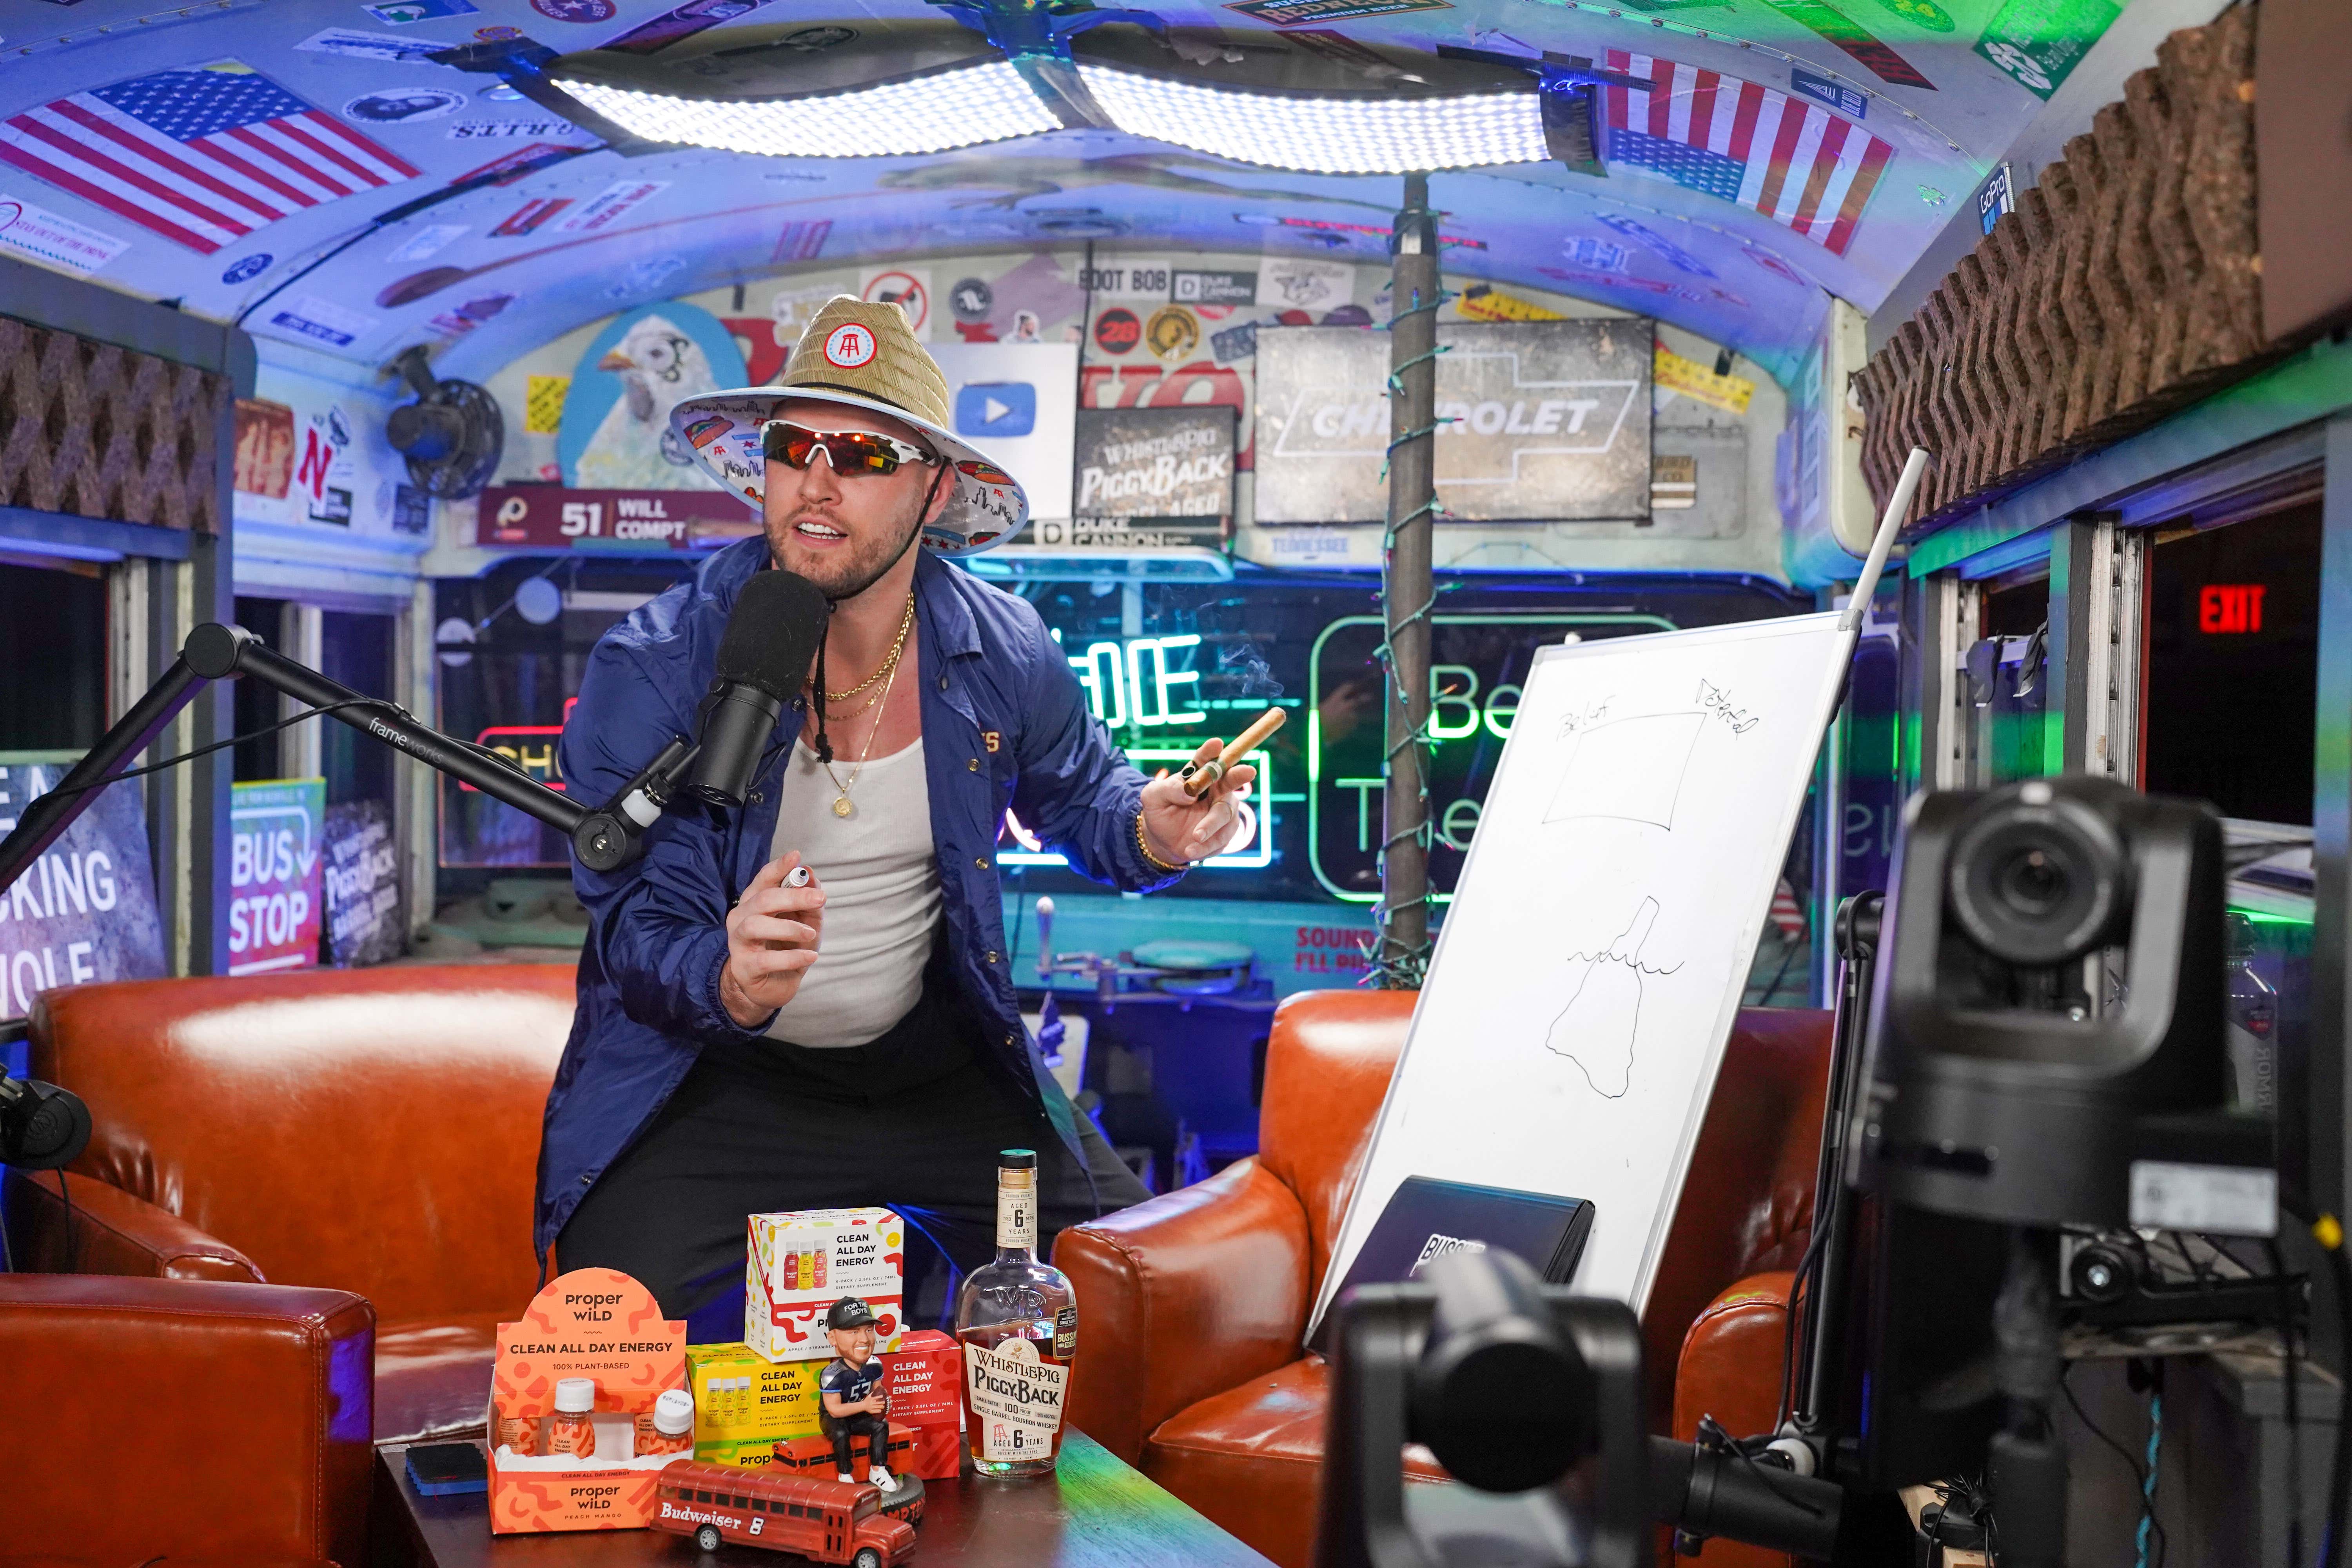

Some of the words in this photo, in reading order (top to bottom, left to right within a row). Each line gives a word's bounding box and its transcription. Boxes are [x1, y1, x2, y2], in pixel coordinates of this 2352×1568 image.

[1301, 9, 1368, 20] PREMIUM
[1980, 175, 2005, 214] GoPro
[1132, 270, 1166, 291] BOB
[1079, 453, 1228, 509] PIGGYBACK
[559, 502, 603, 536] 51
[617, 499, 668, 518] WILL
[615, 520, 686, 540] COMPT
[2200, 584, 2267, 634] EXIT
[231, 828, 294, 887] BUS
[229, 890, 308, 953] STOP
[1015, 1209, 1024, 1227] 6
[837, 1234, 869, 1243] CLEAN
[837, 1247, 855, 1255] ALL
[858, 1245, 877, 1254] DAY
[836, 1257, 875, 1267] ENERGY
[844, 1304, 858, 1312] FOR
[851, 1307, 867, 1316] BOYS
[510, 1344, 556, 1354] CLEAN
[559, 1344, 585, 1353] ALL
[589, 1343, 615, 1353] DAY
[619, 1342, 673, 1352] ENERGY
[893, 1361, 926, 1371] CLEAN
[974, 1348, 1060, 1383] WHISTLEPIG
[761, 1371, 795, 1380] CLEAN
[893, 1374, 912, 1383] ALL
[914, 1372, 934, 1381] DAY
[761, 1383, 780, 1392] ALL
[782, 1382, 802, 1391] DAY
[893, 1383, 932, 1395] ENERGY
[974, 1365, 1060, 1406] PIGGYBACK
[760, 1394, 801, 1404] ENERGY
[974, 1403, 990, 1415] SINGLE
[992, 1410, 1011, 1421] BARREL
[1013, 1416, 1035, 1426] BOURBON
[1005, 1403, 1018, 1414] 100
[1014, 1430, 1023, 1448] 6
[1026, 1437, 1043, 1446] YEARS
[660, 1502, 741, 1530] Budweiser
[749, 1516, 764, 1535] 8
